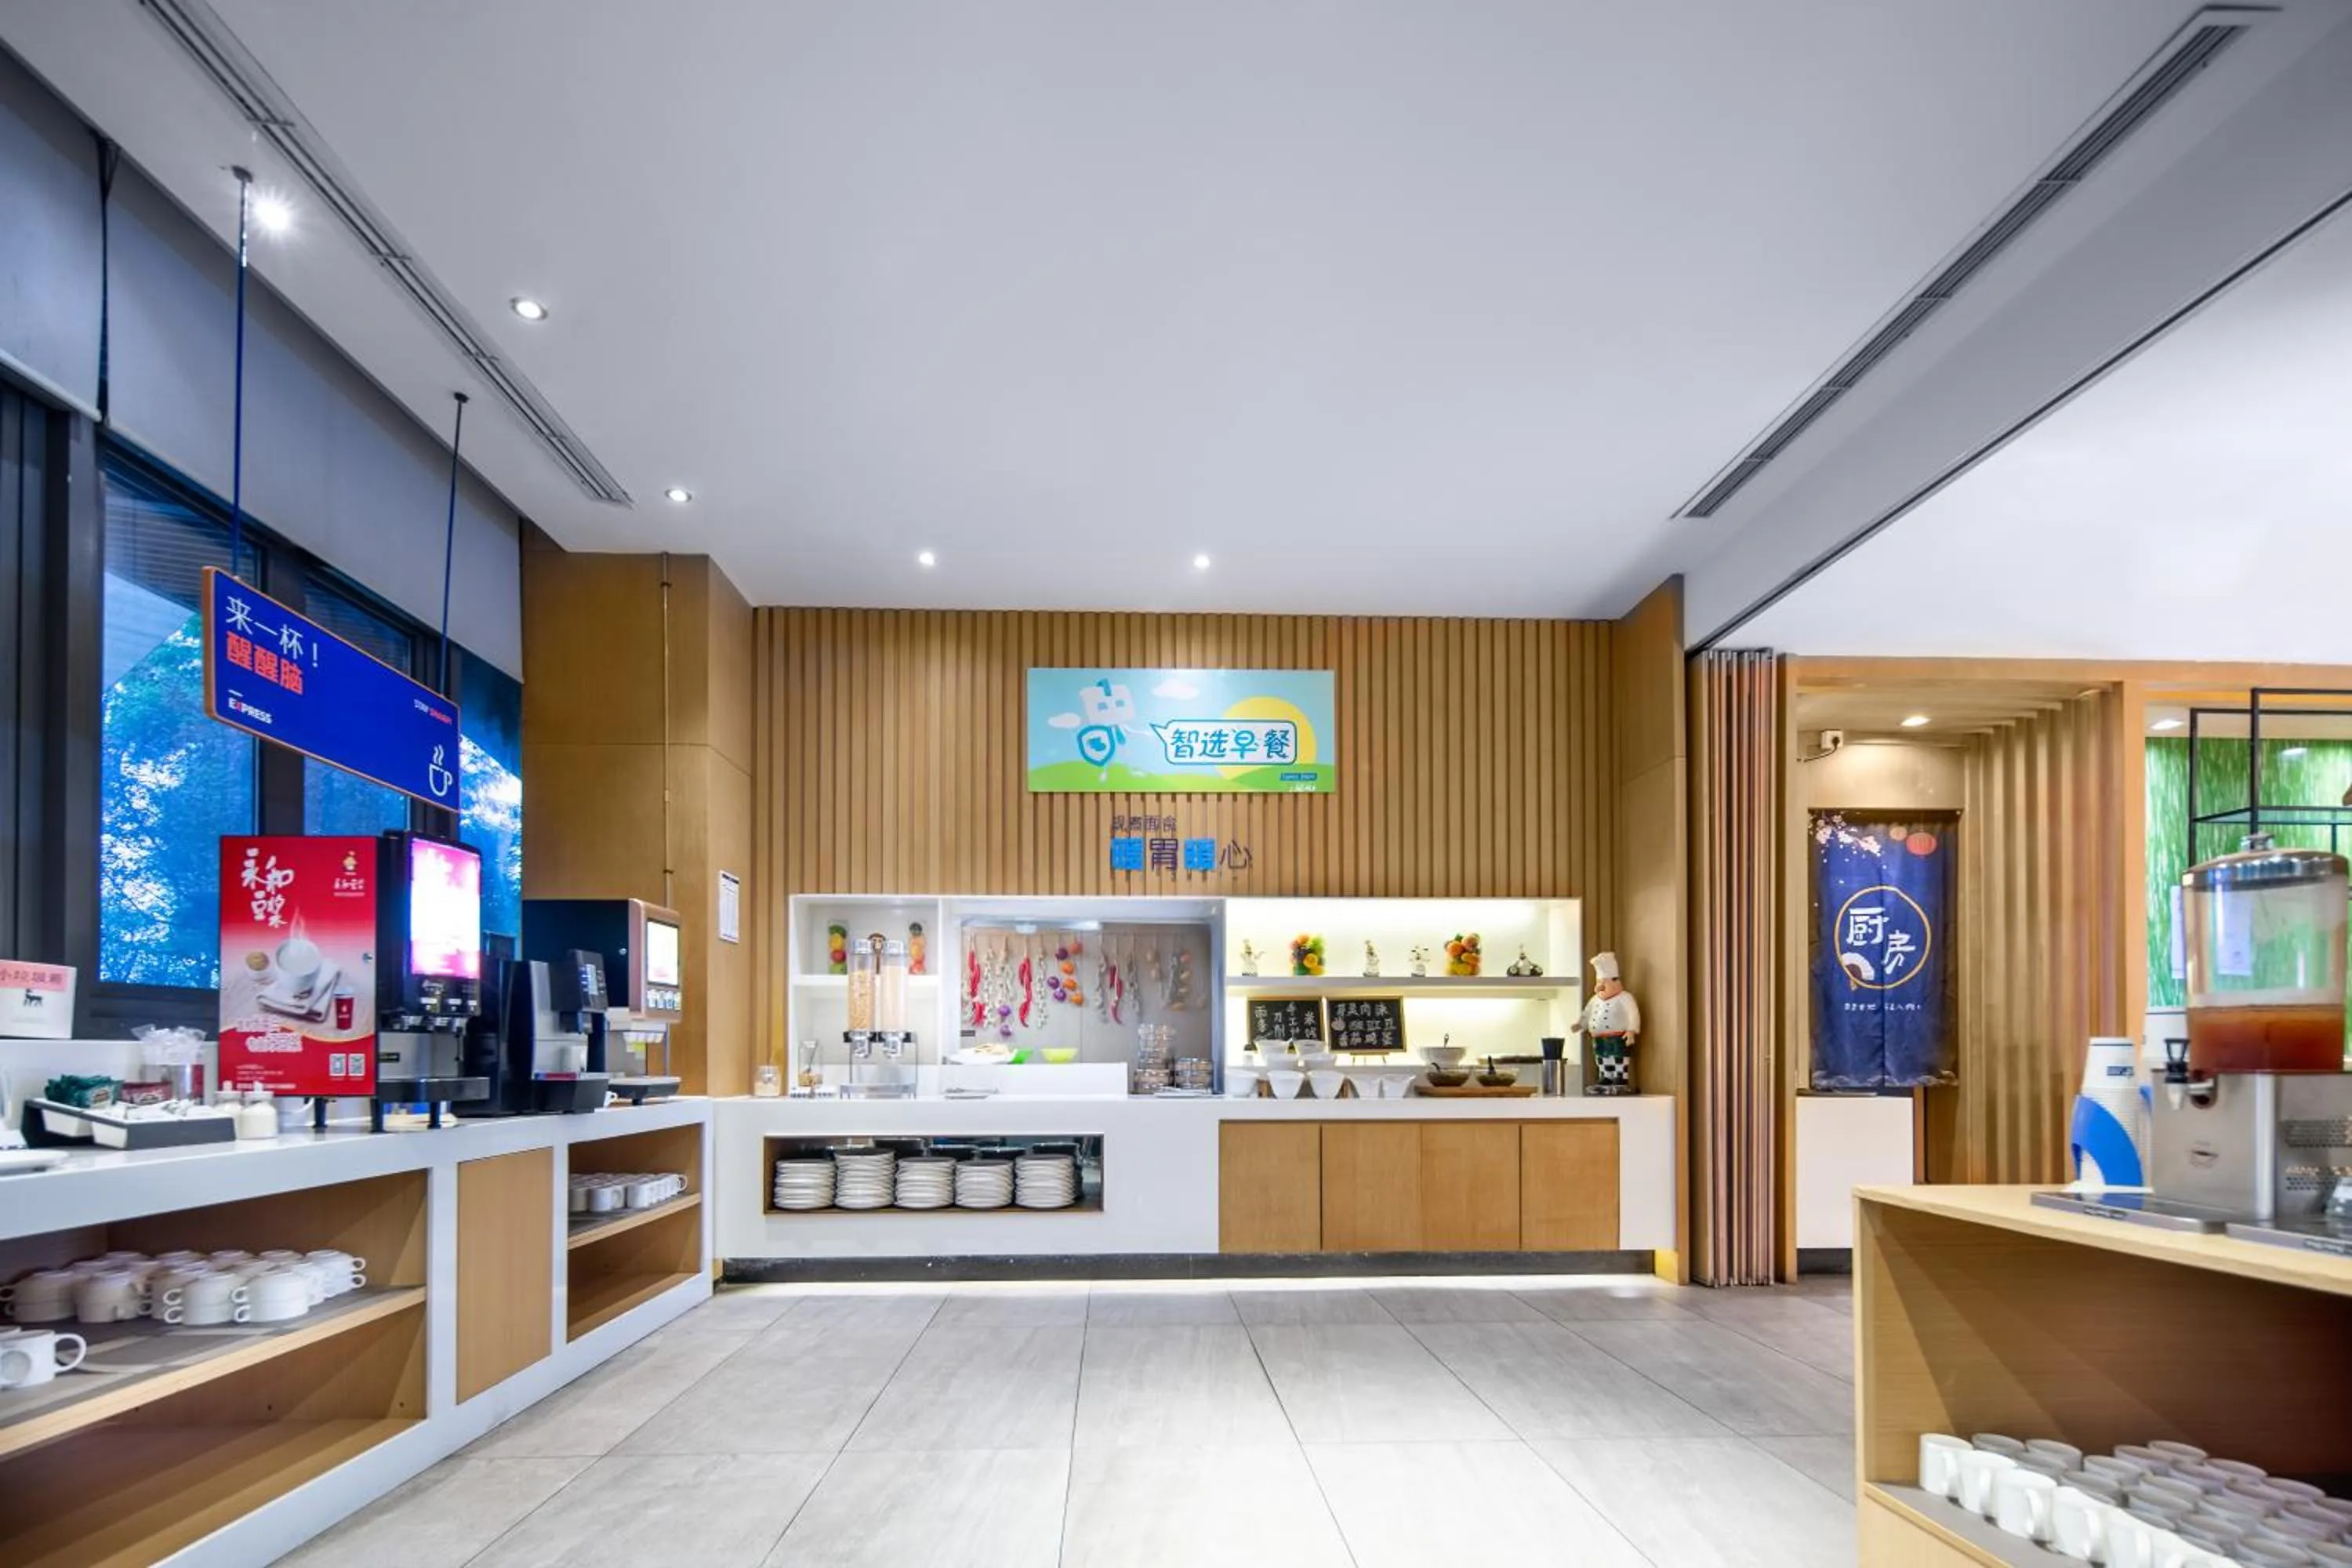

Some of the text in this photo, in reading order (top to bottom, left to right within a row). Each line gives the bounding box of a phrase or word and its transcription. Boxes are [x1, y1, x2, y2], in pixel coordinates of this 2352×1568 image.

[226, 596, 318, 668] 来一杯！
[1170, 728, 1292, 760] 智选早餐
[241, 848, 295, 892] 永和
[1846, 907, 1916, 975] 厨房
